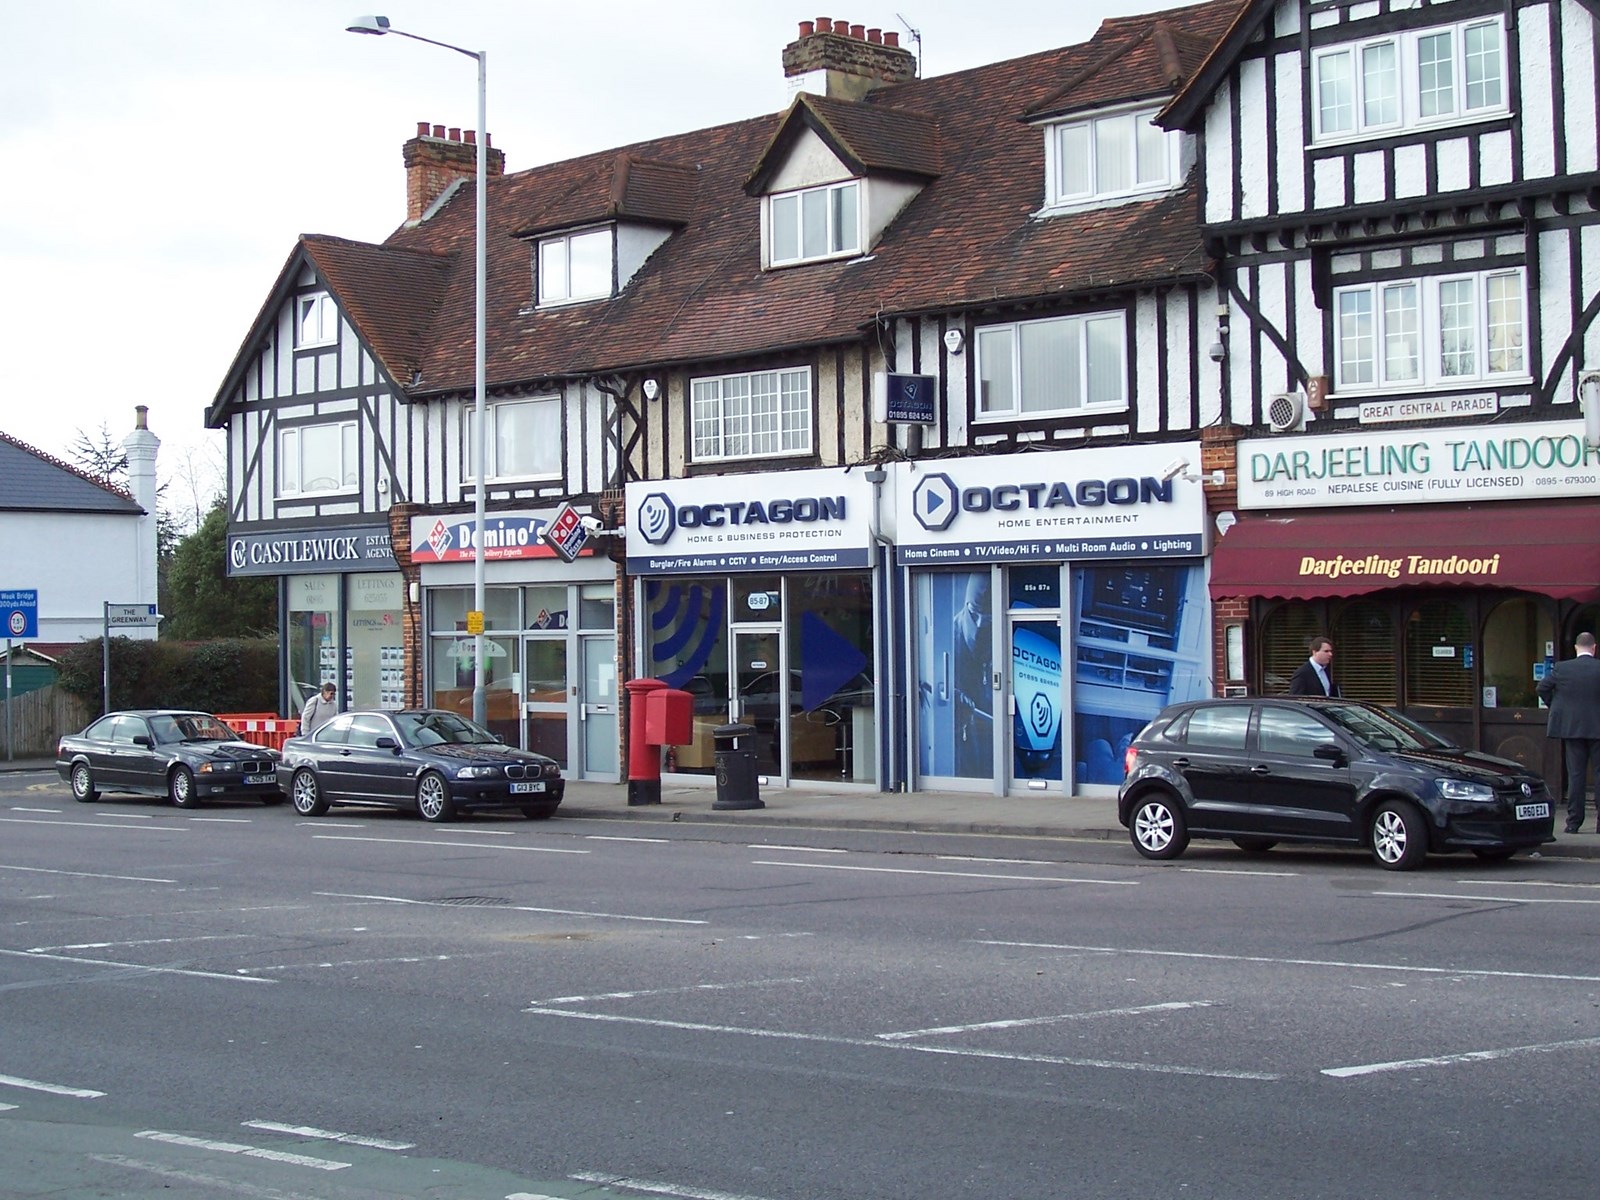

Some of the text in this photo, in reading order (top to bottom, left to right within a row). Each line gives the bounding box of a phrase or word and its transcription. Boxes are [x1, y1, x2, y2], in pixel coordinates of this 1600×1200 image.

[1363, 397, 1492, 418] GREAT CENTRAL PARADE
[1251, 442, 1430, 482] DARJEELING
[1276, 489, 1294, 497] HIGH
[1296, 488, 1316, 496] ROAD
[1328, 475, 1524, 494] NEPALESE CUISINE (FULLY LICENSED)
[962, 476, 1173, 512] OCTAGON
[678, 496, 846, 528] OCTAGON
[998, 514, 1139, 528] HOME ENTERTAINMENT
[687, 535, 714, 543] HOME
[727, 532, 775, 541] BUSINESS
[780, 530, 842, 538] PROTECTION
[251, 537, 360, 564] CASTLEWICK
[366, 548, 394, 558] AGENTS
[504, 549, 522, 558] Experts
[905, 549, 928, 558] Home
[930, 548, 960, 557] Cinema
[1032, 544, 1040, 553] Fi
[1056, 543, 1080, 553] Multi
[1082, 543, 1106, 552] Room
[1110, 542, 1136, 551] Audio
[1154, 540, 1192, 551] Lighting
[650, 553, 838, 569] Burglar/Fire Alarms CCTV Entry/Access Control
[1299, 554, 1500, 578] Darjeeling Tandoori
[357, 578, 394, 589] LETTINGS
[16, 592, 34, 600] Bridge
